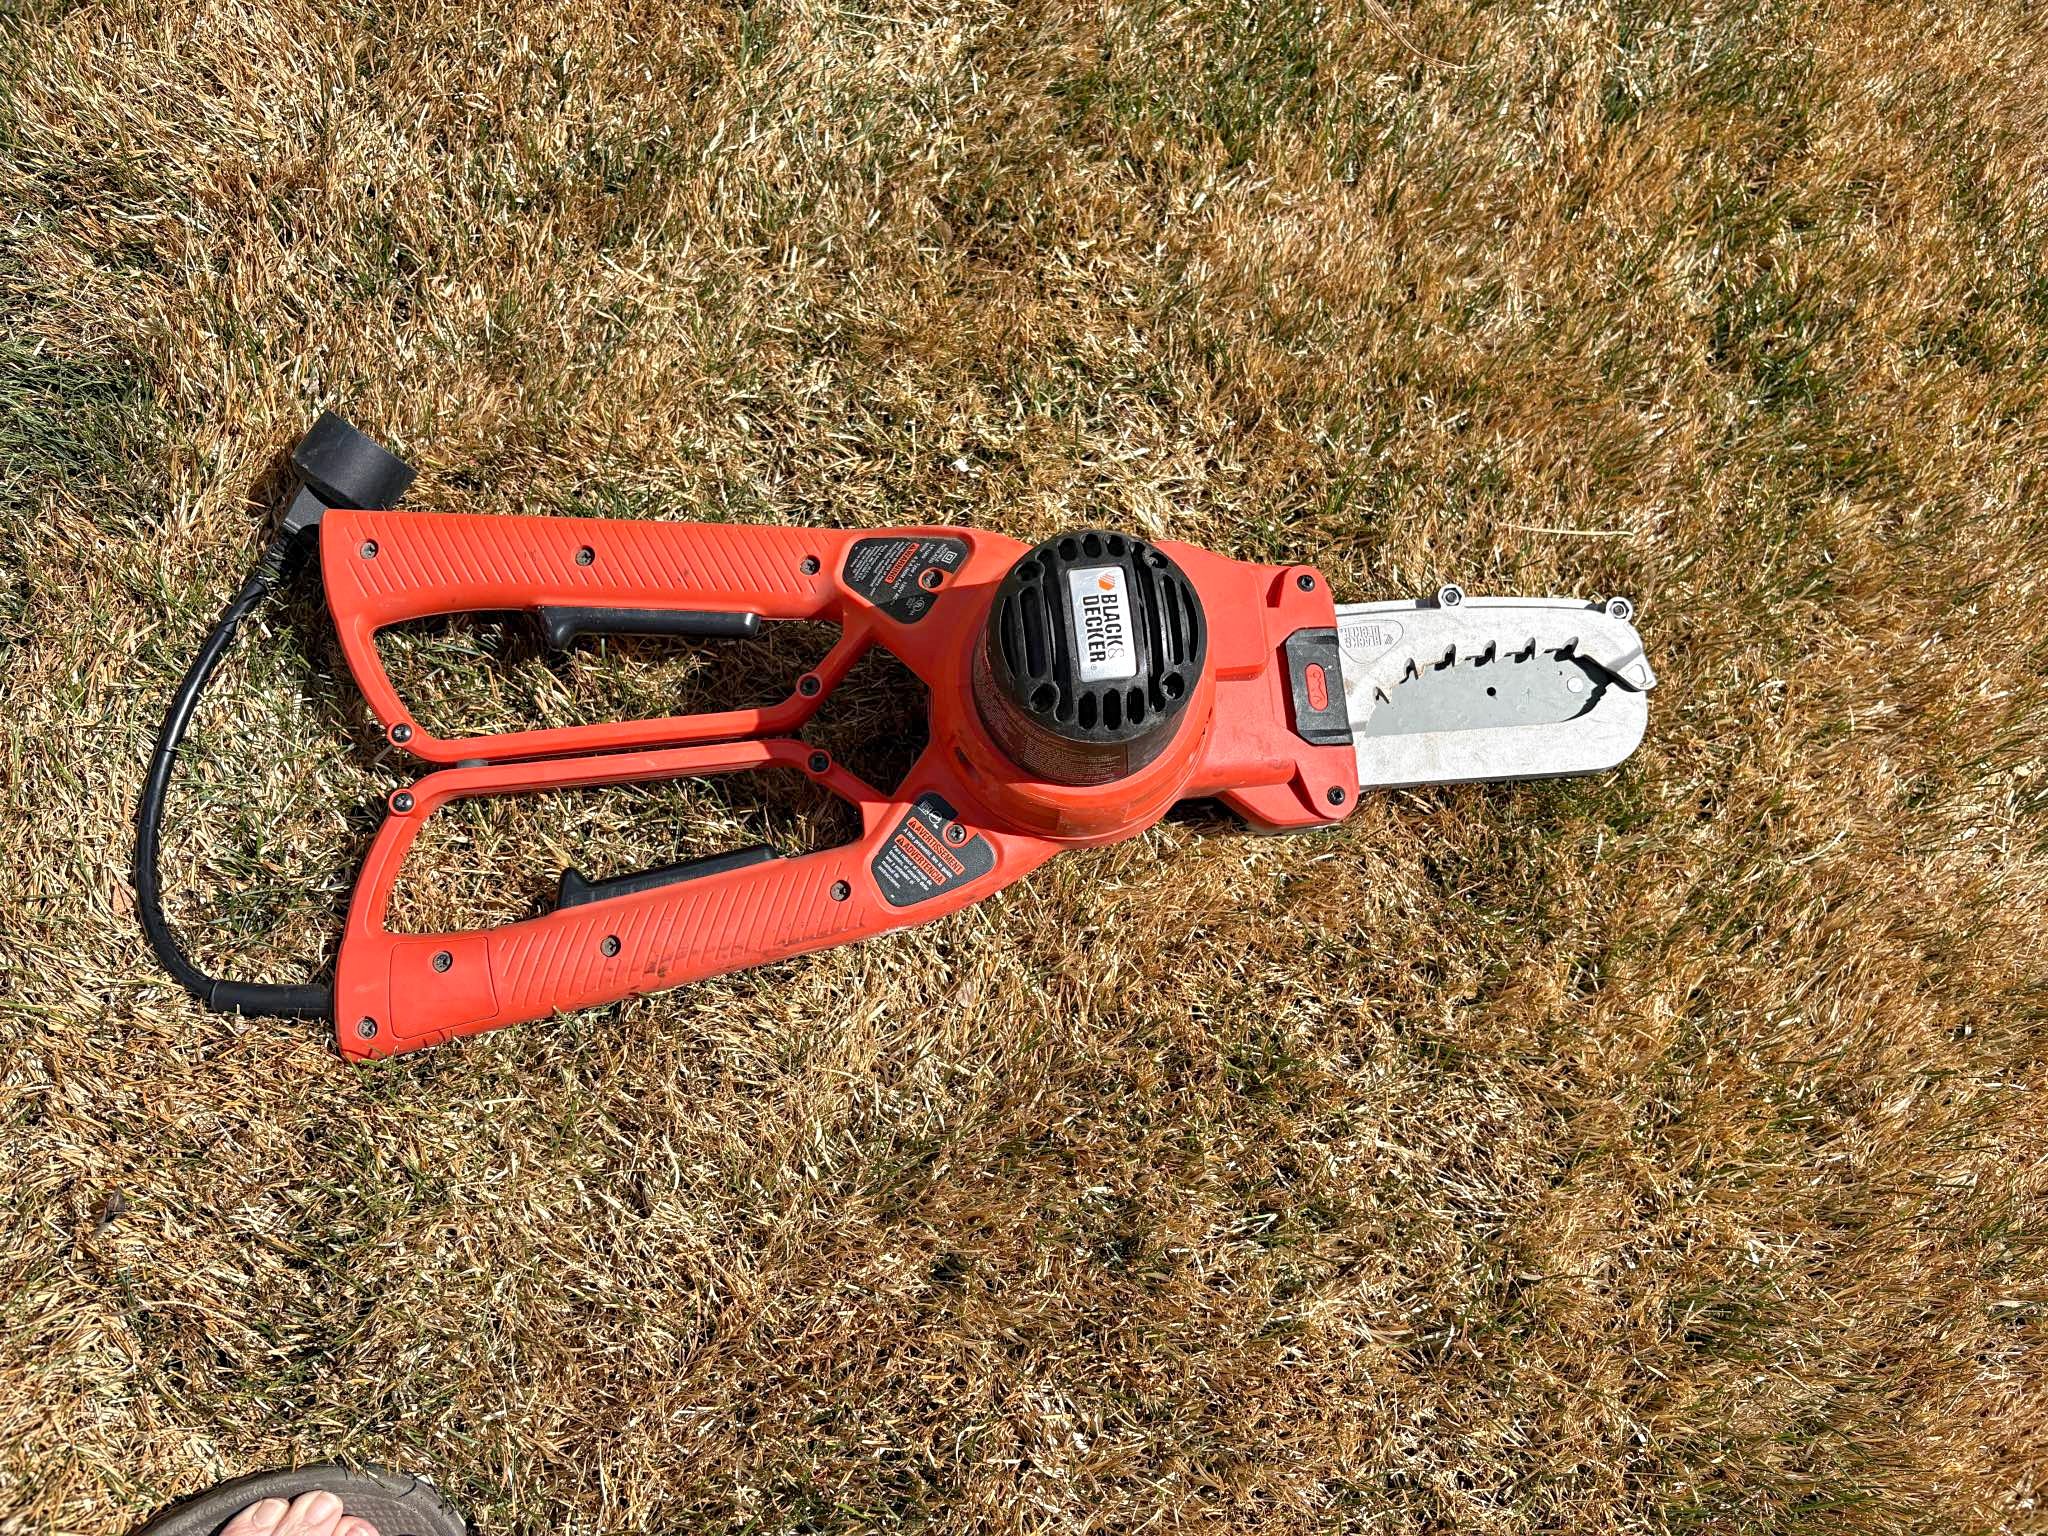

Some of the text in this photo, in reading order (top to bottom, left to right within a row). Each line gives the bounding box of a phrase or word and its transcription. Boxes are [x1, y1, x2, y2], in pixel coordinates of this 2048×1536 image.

[886, 549, 912, 582] WARNING
[1082, 594, 1106, 663] DECKER
[902, 842, 943, 883] ADVERTENCIA
[914, 824, 962, 872] AVERTISSEMENT
